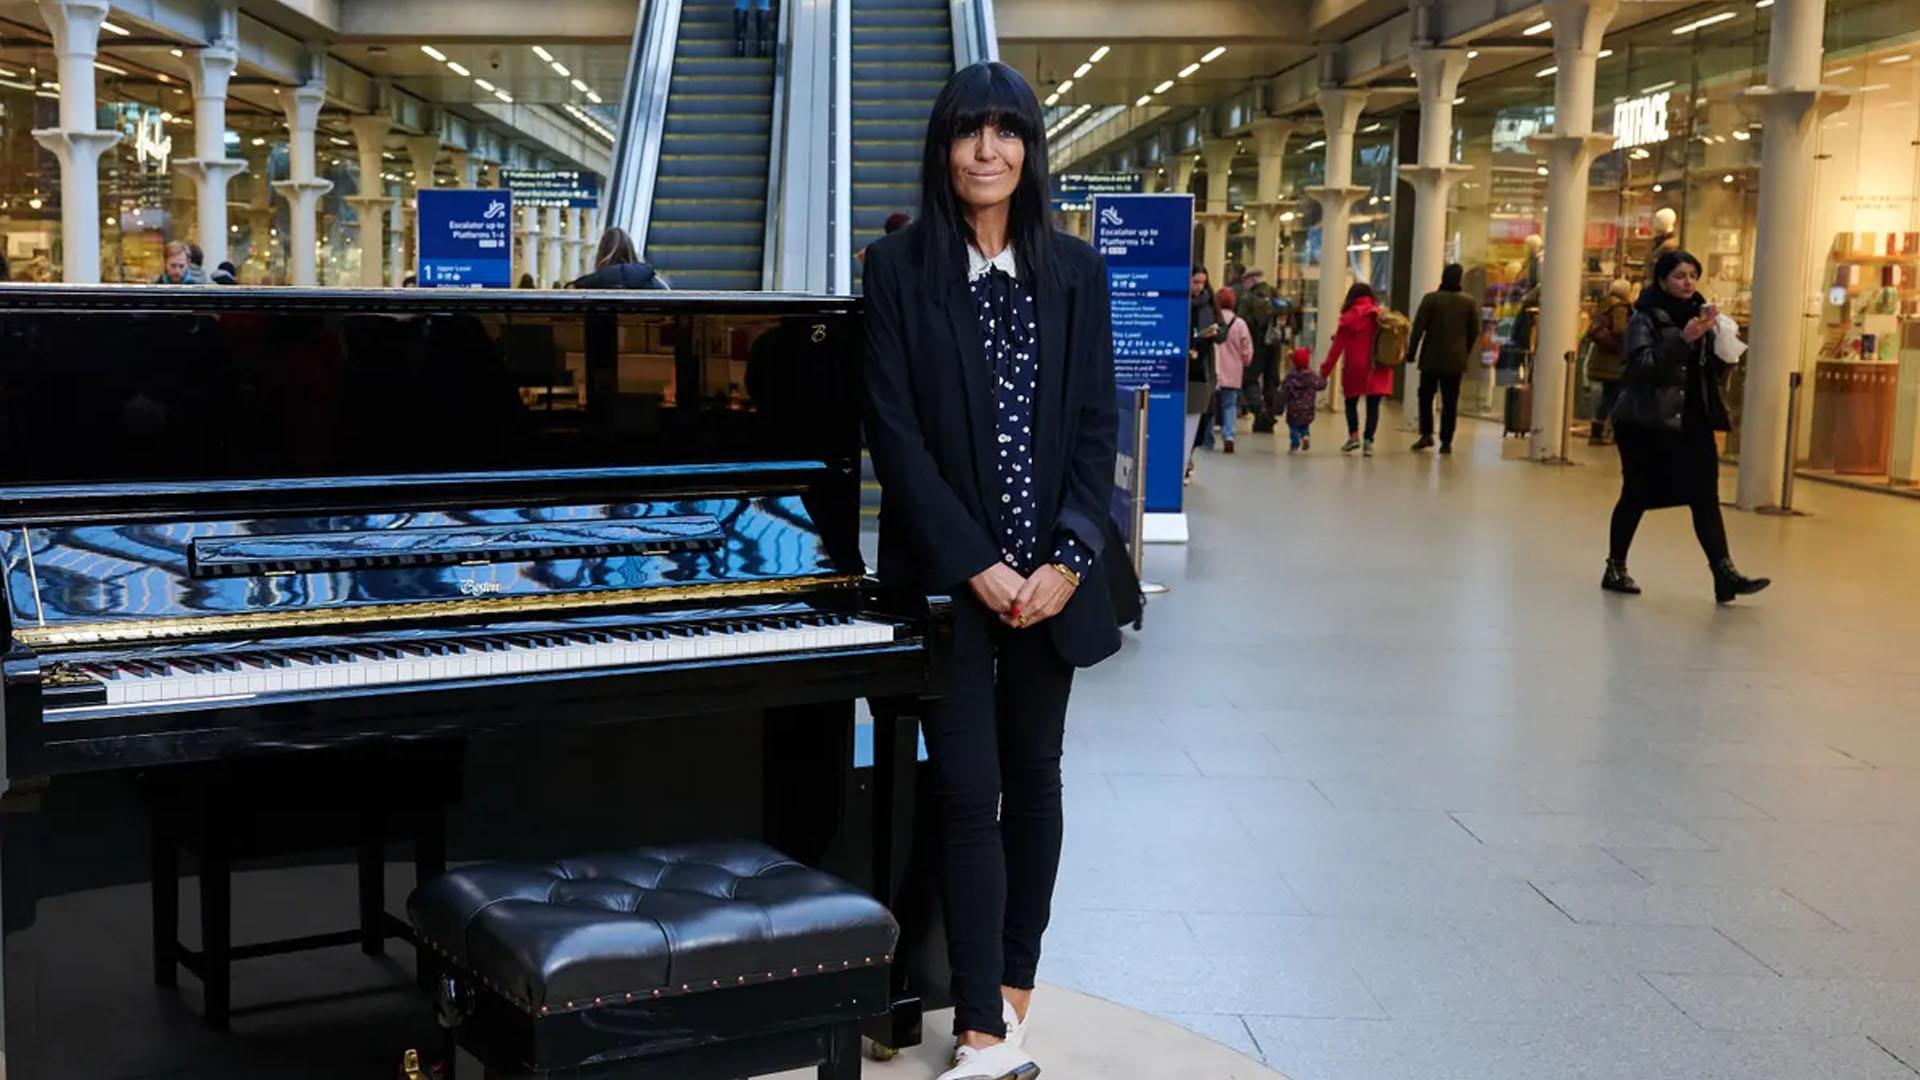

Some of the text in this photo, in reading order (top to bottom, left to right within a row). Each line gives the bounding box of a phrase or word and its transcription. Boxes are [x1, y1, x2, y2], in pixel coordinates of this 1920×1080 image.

[449, 220, 506, 230] Escalator up to
[452, 231, 505, 239] Platforms 1-4
[1100, 228, 1159, 237] Escalator up to
[1100, 237, 1155, 246] Platforms 1-4
[424, 264, 432, 281] 1
